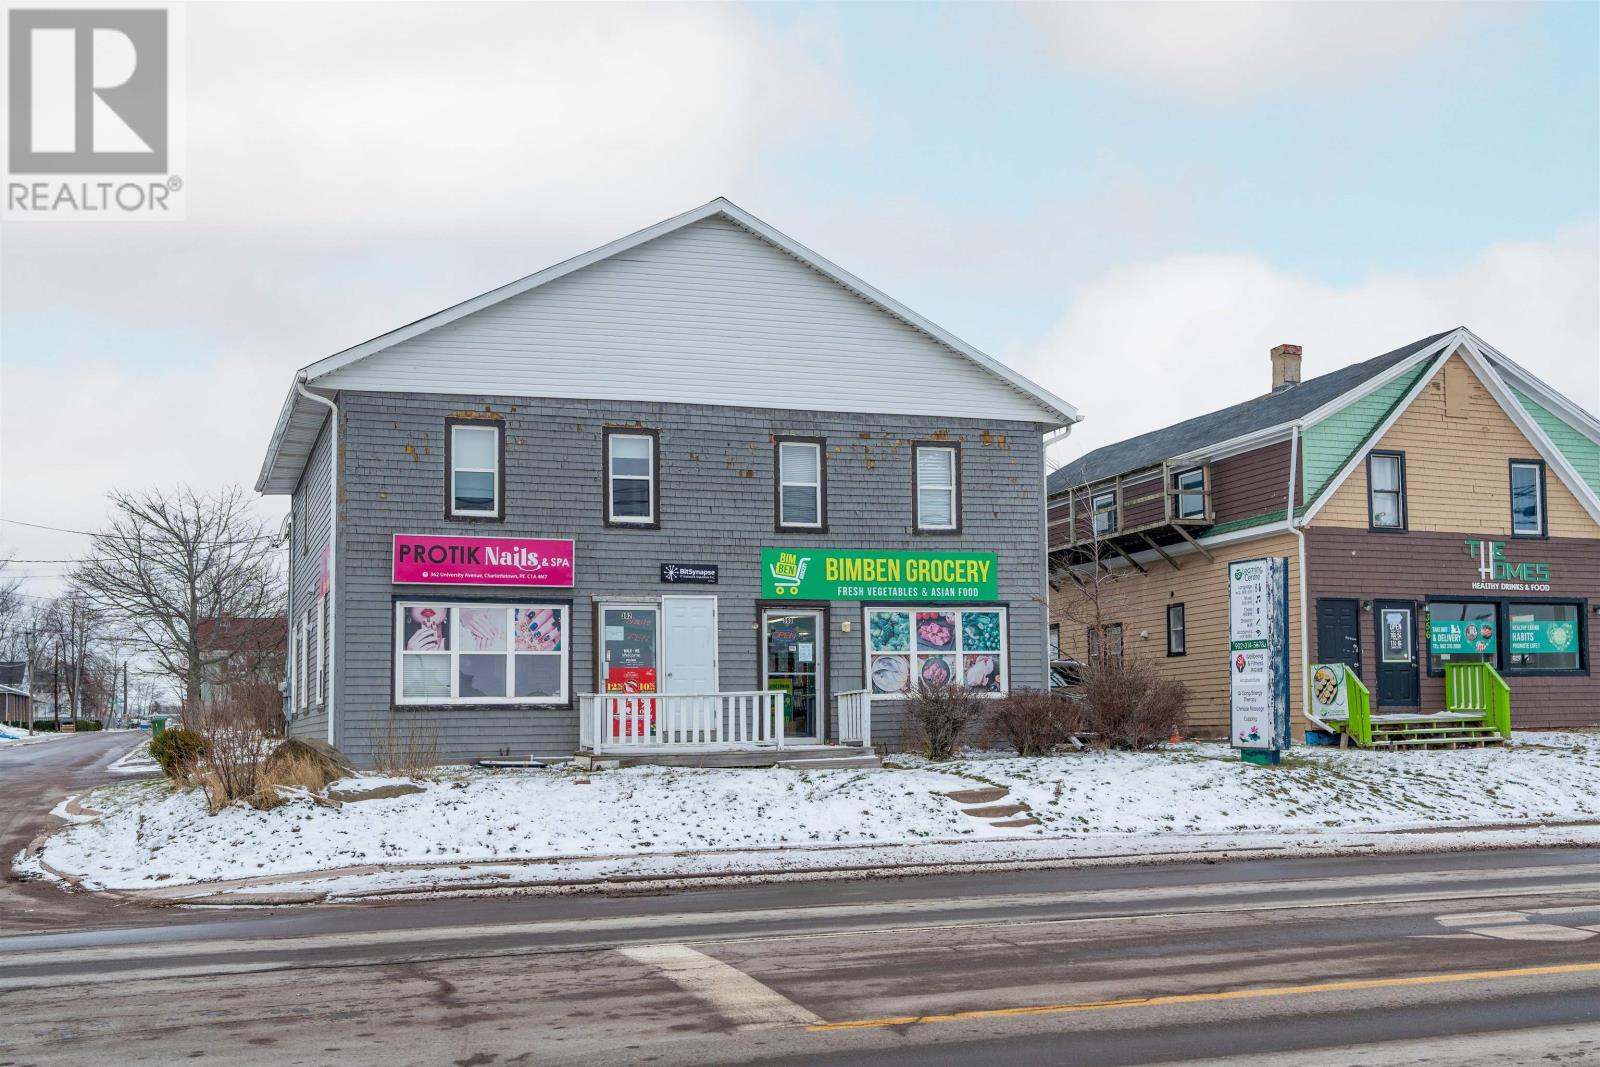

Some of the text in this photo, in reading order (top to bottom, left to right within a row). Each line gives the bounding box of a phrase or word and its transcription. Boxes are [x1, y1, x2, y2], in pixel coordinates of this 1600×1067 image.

[399, 544, 570, 572] PROTIK Nails & SPA
[780, 552, 797, 565] BIM
[680, 568, 716, 577] BitSynapse
[778, 564, 796, 577] BEN
[825, 557, 991, 583] BIMBEN GROCERY
[837, 586, 979, 597] FRESH VEGETABLES & ASIAN FOOD
[1471, 582, 1500, 590] HEALTHY
[1500, 583, 1524, 591] DRINKS
[1531, 584, 1550, 592] FOOD
[1432, 633, 1462, 642] & DELIVERY
[1512, 632, 1534, 642] HABITS
